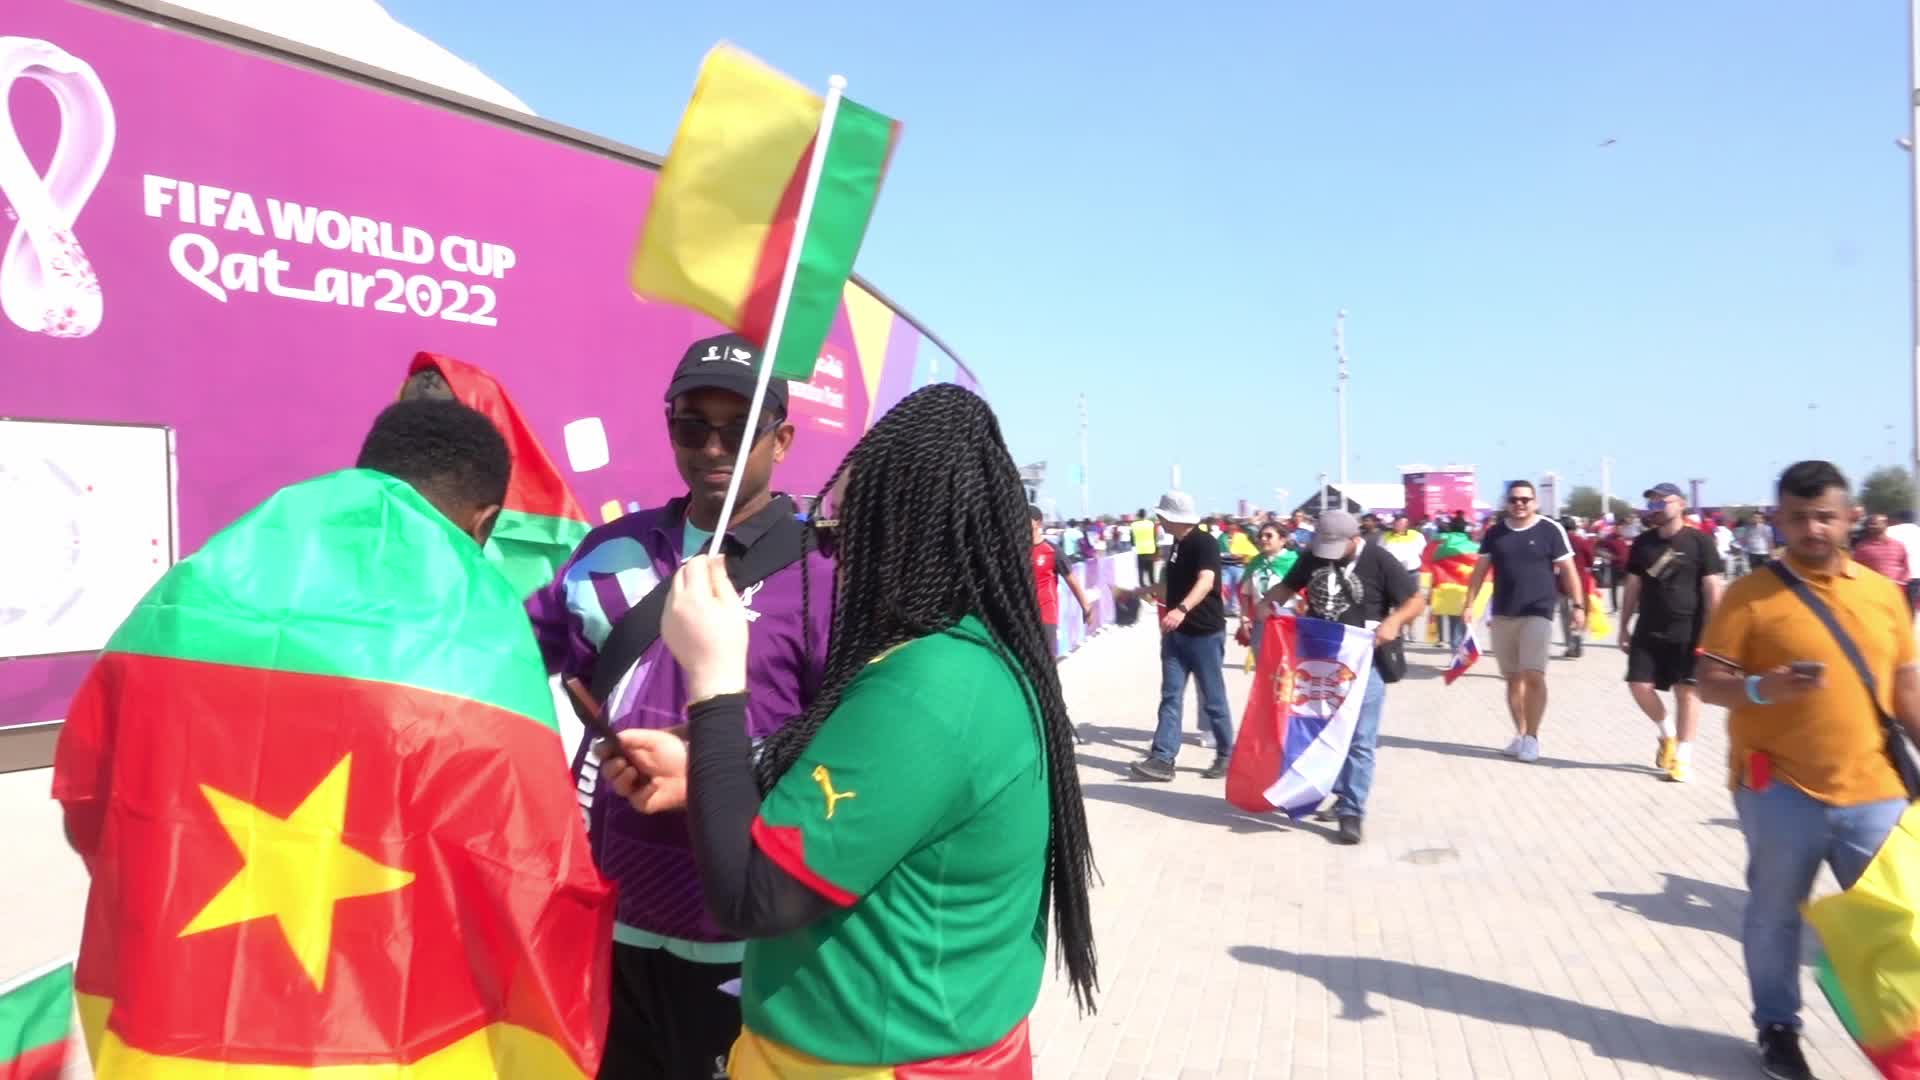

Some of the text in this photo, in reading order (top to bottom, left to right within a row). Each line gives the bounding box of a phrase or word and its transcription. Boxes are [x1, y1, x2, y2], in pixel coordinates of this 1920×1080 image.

[143, 173, 517, 279] FIFA WORLD CUP
[168, 232, 498, 327] Qatar2022
